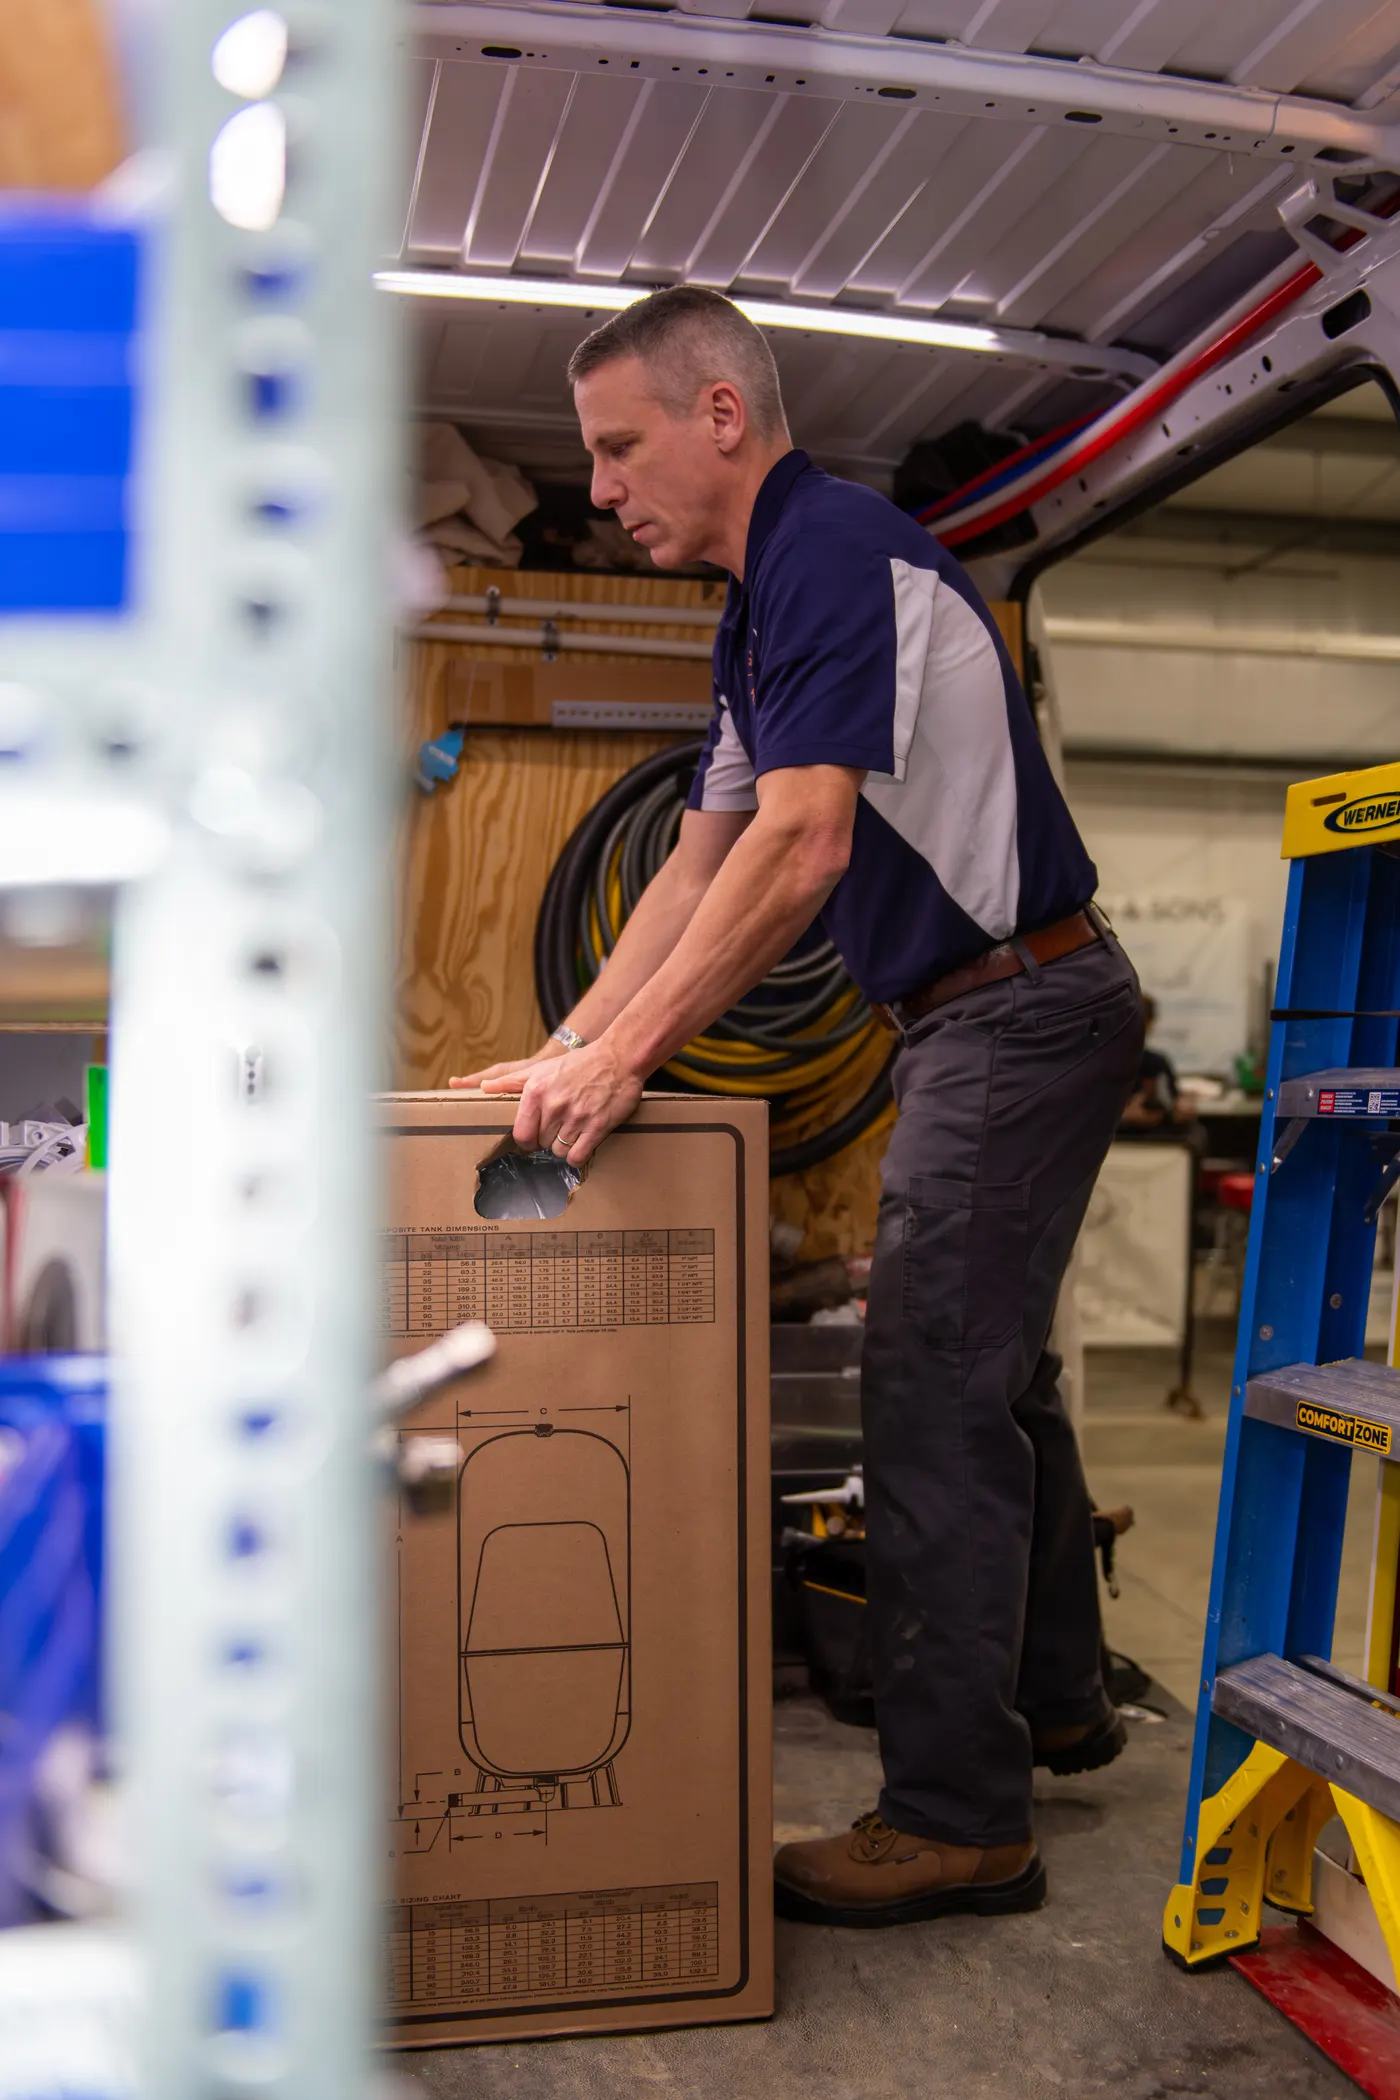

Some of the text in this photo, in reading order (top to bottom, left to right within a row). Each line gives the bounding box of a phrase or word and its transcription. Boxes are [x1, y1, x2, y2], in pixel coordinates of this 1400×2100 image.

[540, 1407, 547, 1415] C
[1298, 1407, 1388, 1447] COMFORT ZONE
[495, 1831, 502, 1839] D
[400, 1893, 462, 1904] SIZING CHART
